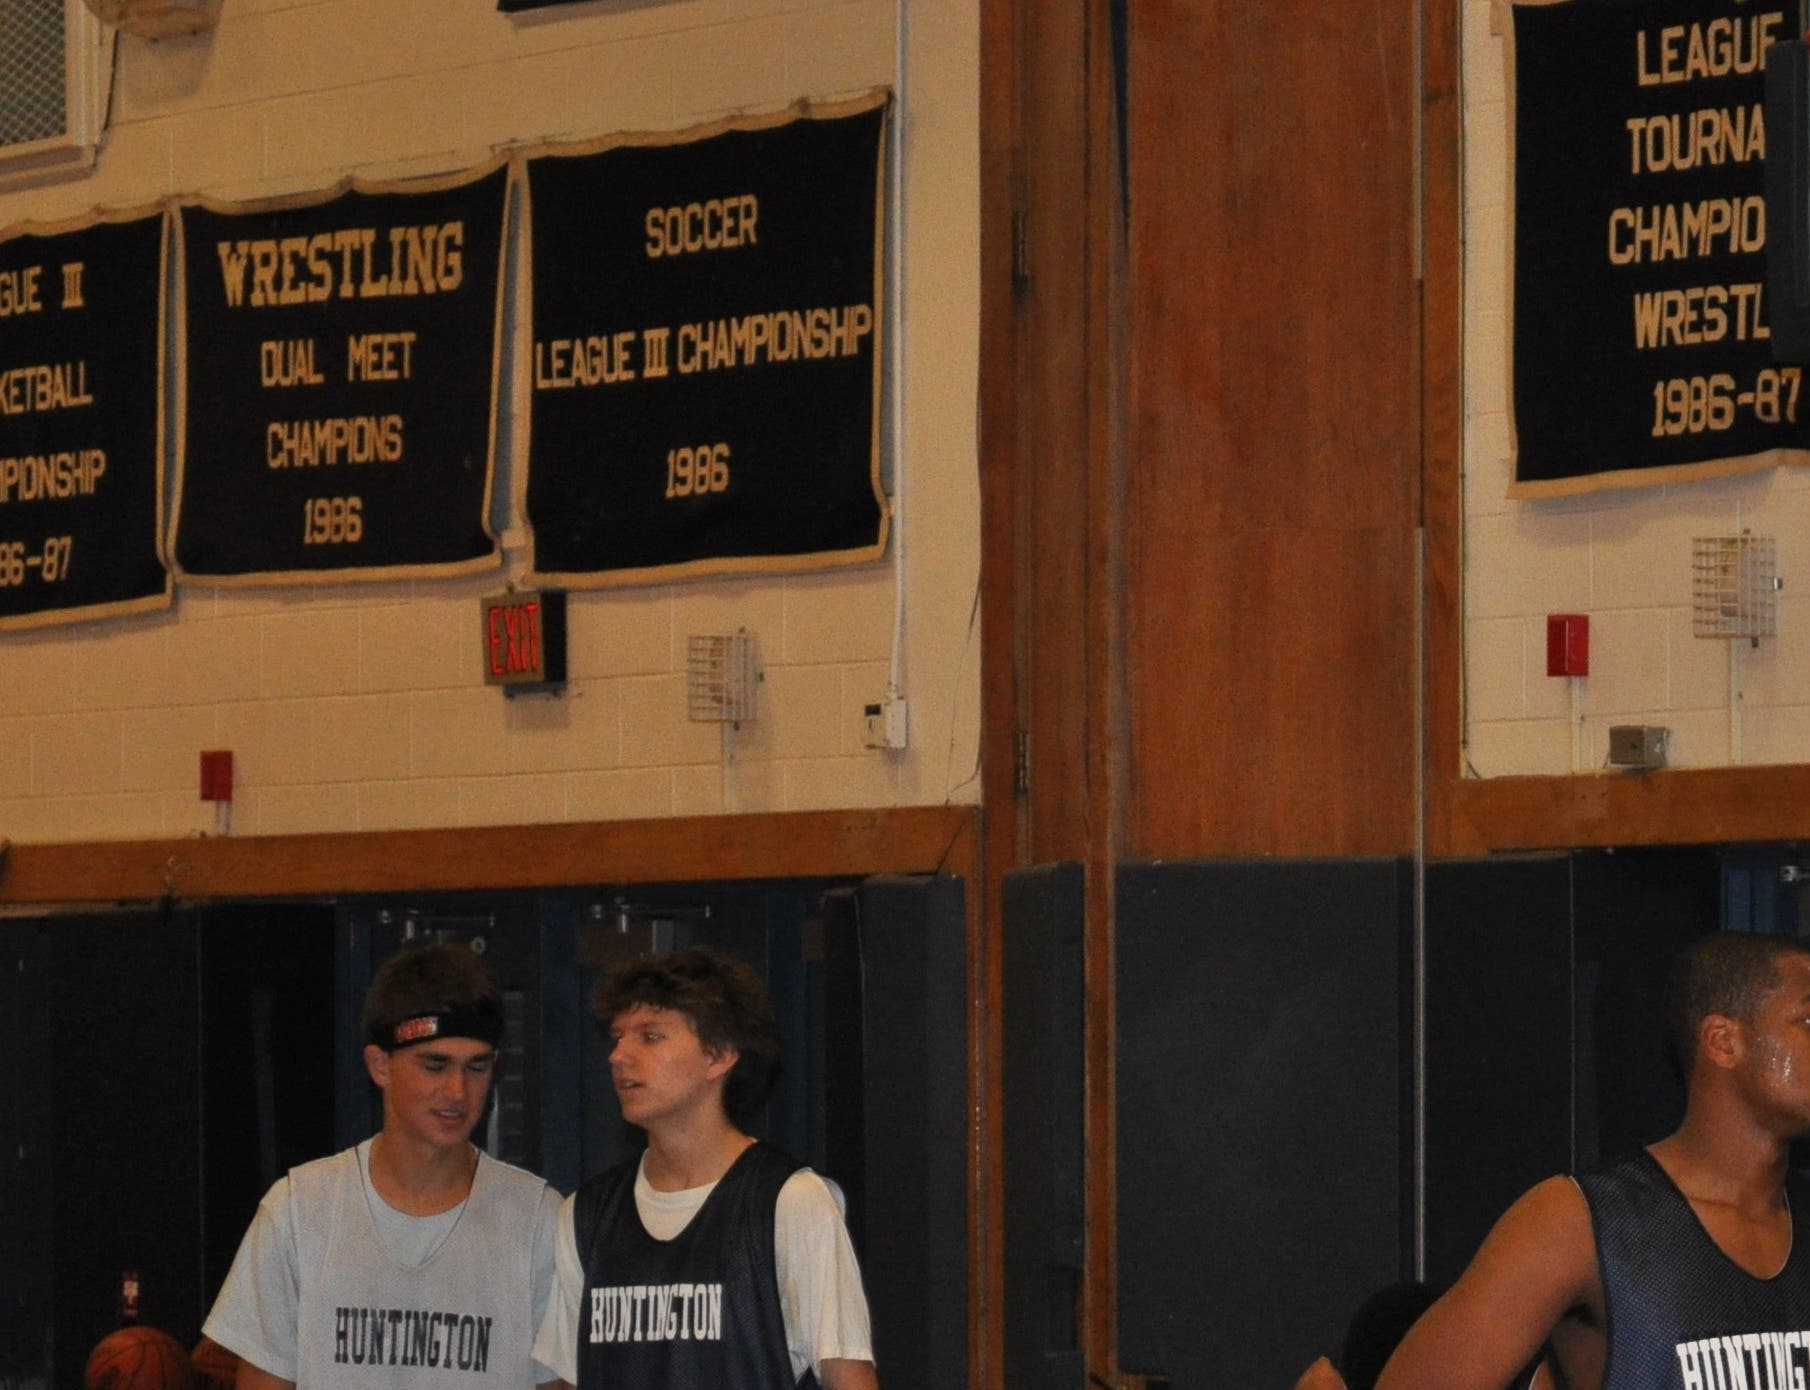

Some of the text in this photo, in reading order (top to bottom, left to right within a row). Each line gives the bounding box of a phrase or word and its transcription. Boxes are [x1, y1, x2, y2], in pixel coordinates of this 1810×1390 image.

[1626, 103, 1766, 175] TOURNA
[645, 194, 758, 259] SOCCER
[1608, 195, 1766, 266] CHAMPIO
[62, 262, 84, 309] III
[217, 220, 464, 308] WRESTLING
[536, 303, 875, 390] LEAGUE III CHAMPIONSHIP
[1634, 283, 1771, 350] WRESTL
[260, 332, 417, 388] DUAL MEET
[1651, 367, 1802, 438] 1986-87
[267, 414, 403, 469] CHAMPIONS
[665, 442, 731, 499] 1986
[0, 448, 107, 502] PIONSHIP
[303, 495, 364, 545] 1986
[488, 602, 540, 676] EXIT
[335, 1307, 492, 1373] HUNTINGTON
[589, 1283, 723, 1344] HUNTINGTON
